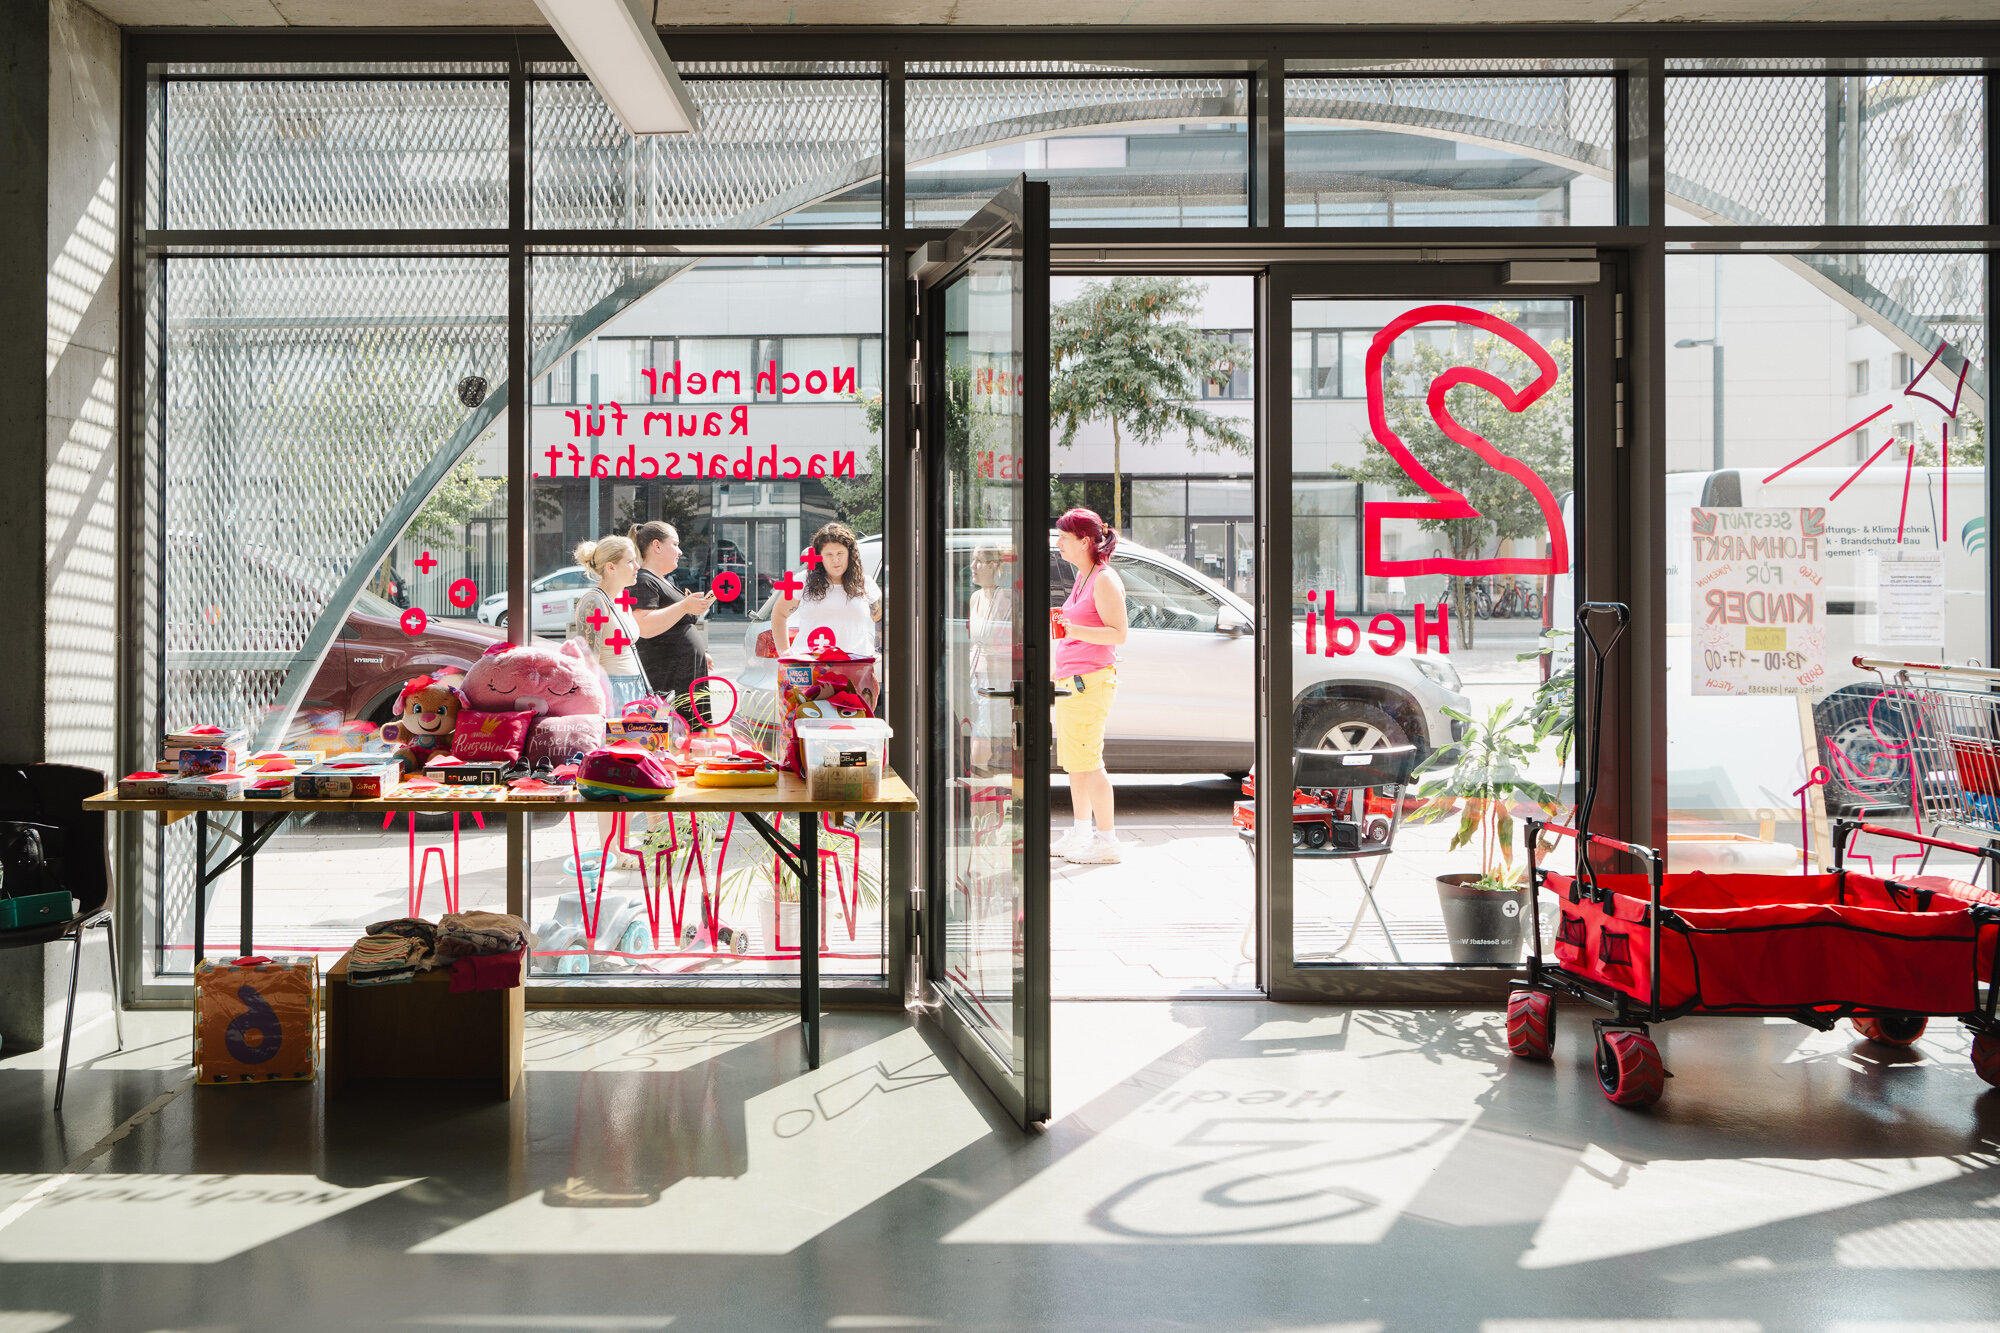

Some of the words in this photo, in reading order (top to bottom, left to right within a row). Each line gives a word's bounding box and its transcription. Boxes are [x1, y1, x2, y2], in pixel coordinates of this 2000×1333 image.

[1872, 525, 1930, 533] Klimaechnik
[1841, 537, 1897, 545] Brandschutz
[1903, 537, 1920, 545] Bau
